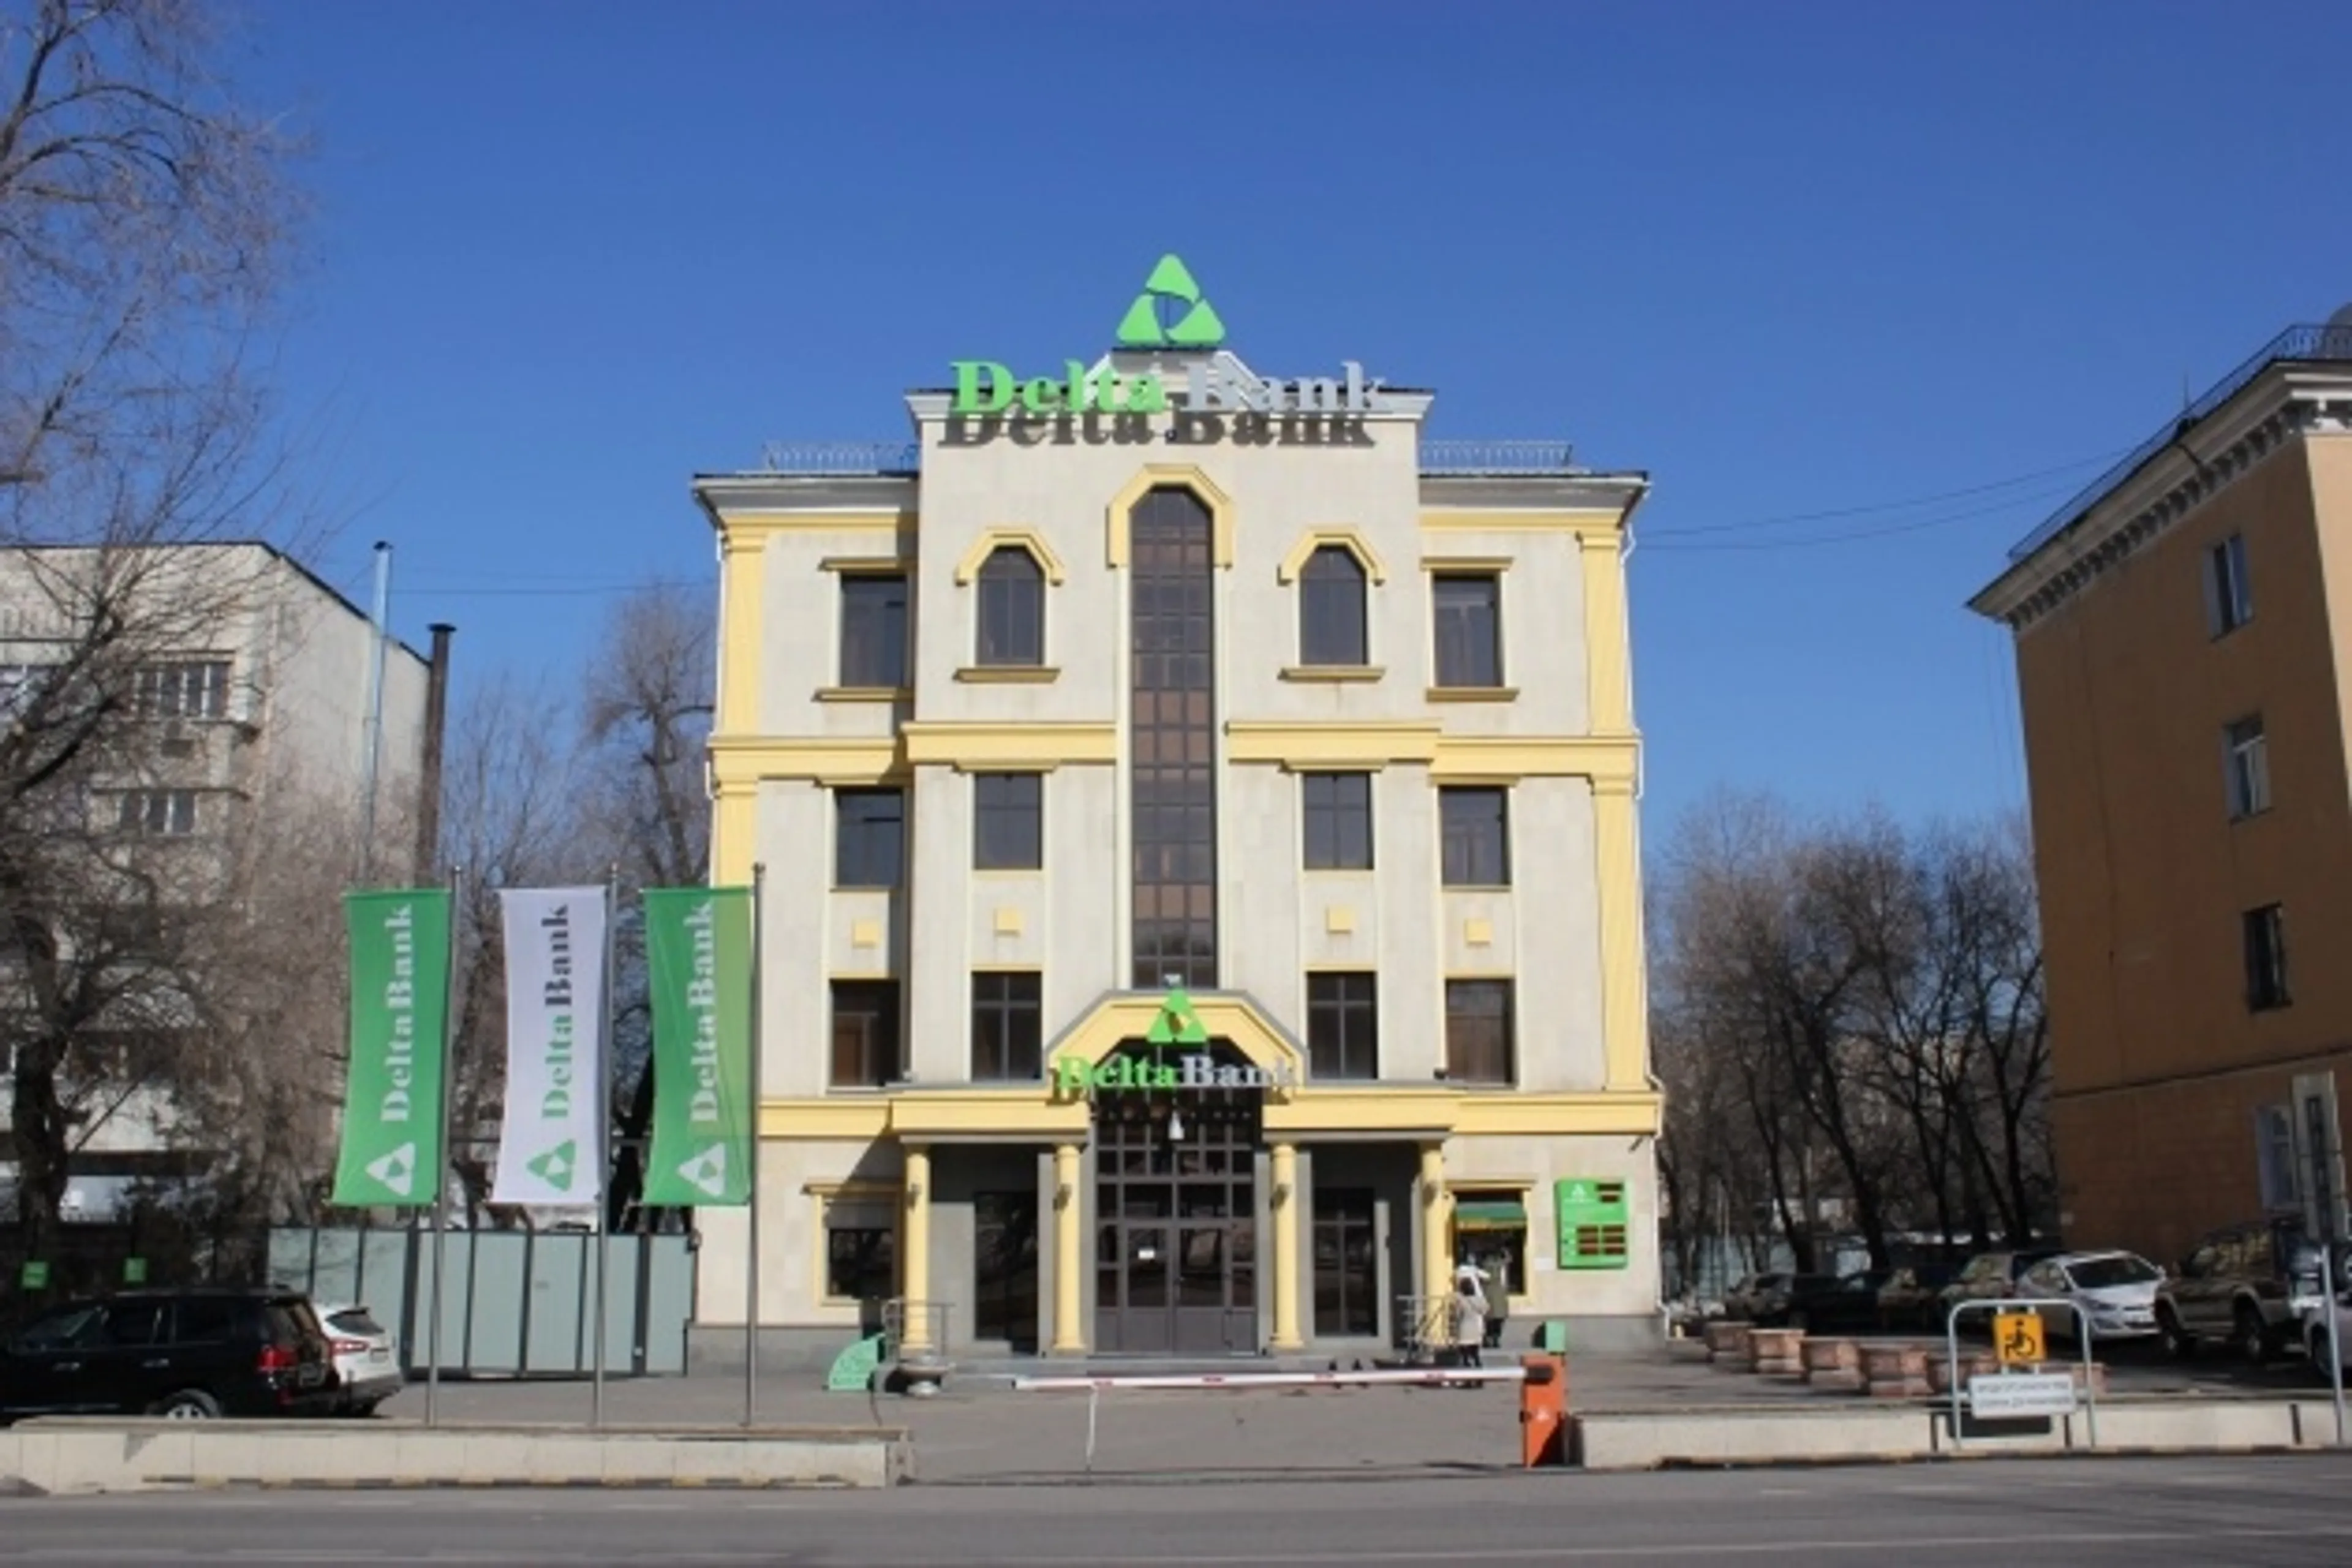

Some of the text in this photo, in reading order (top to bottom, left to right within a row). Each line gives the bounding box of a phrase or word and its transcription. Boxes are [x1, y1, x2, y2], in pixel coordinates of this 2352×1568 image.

[949, 360, 1393, 414] Delta Bank
[380, 903, 413, 1122] Delta Bank
[541, 903, 572, 1119] Delta Bank
[684, 901, 718, 1122] Delta Bank
